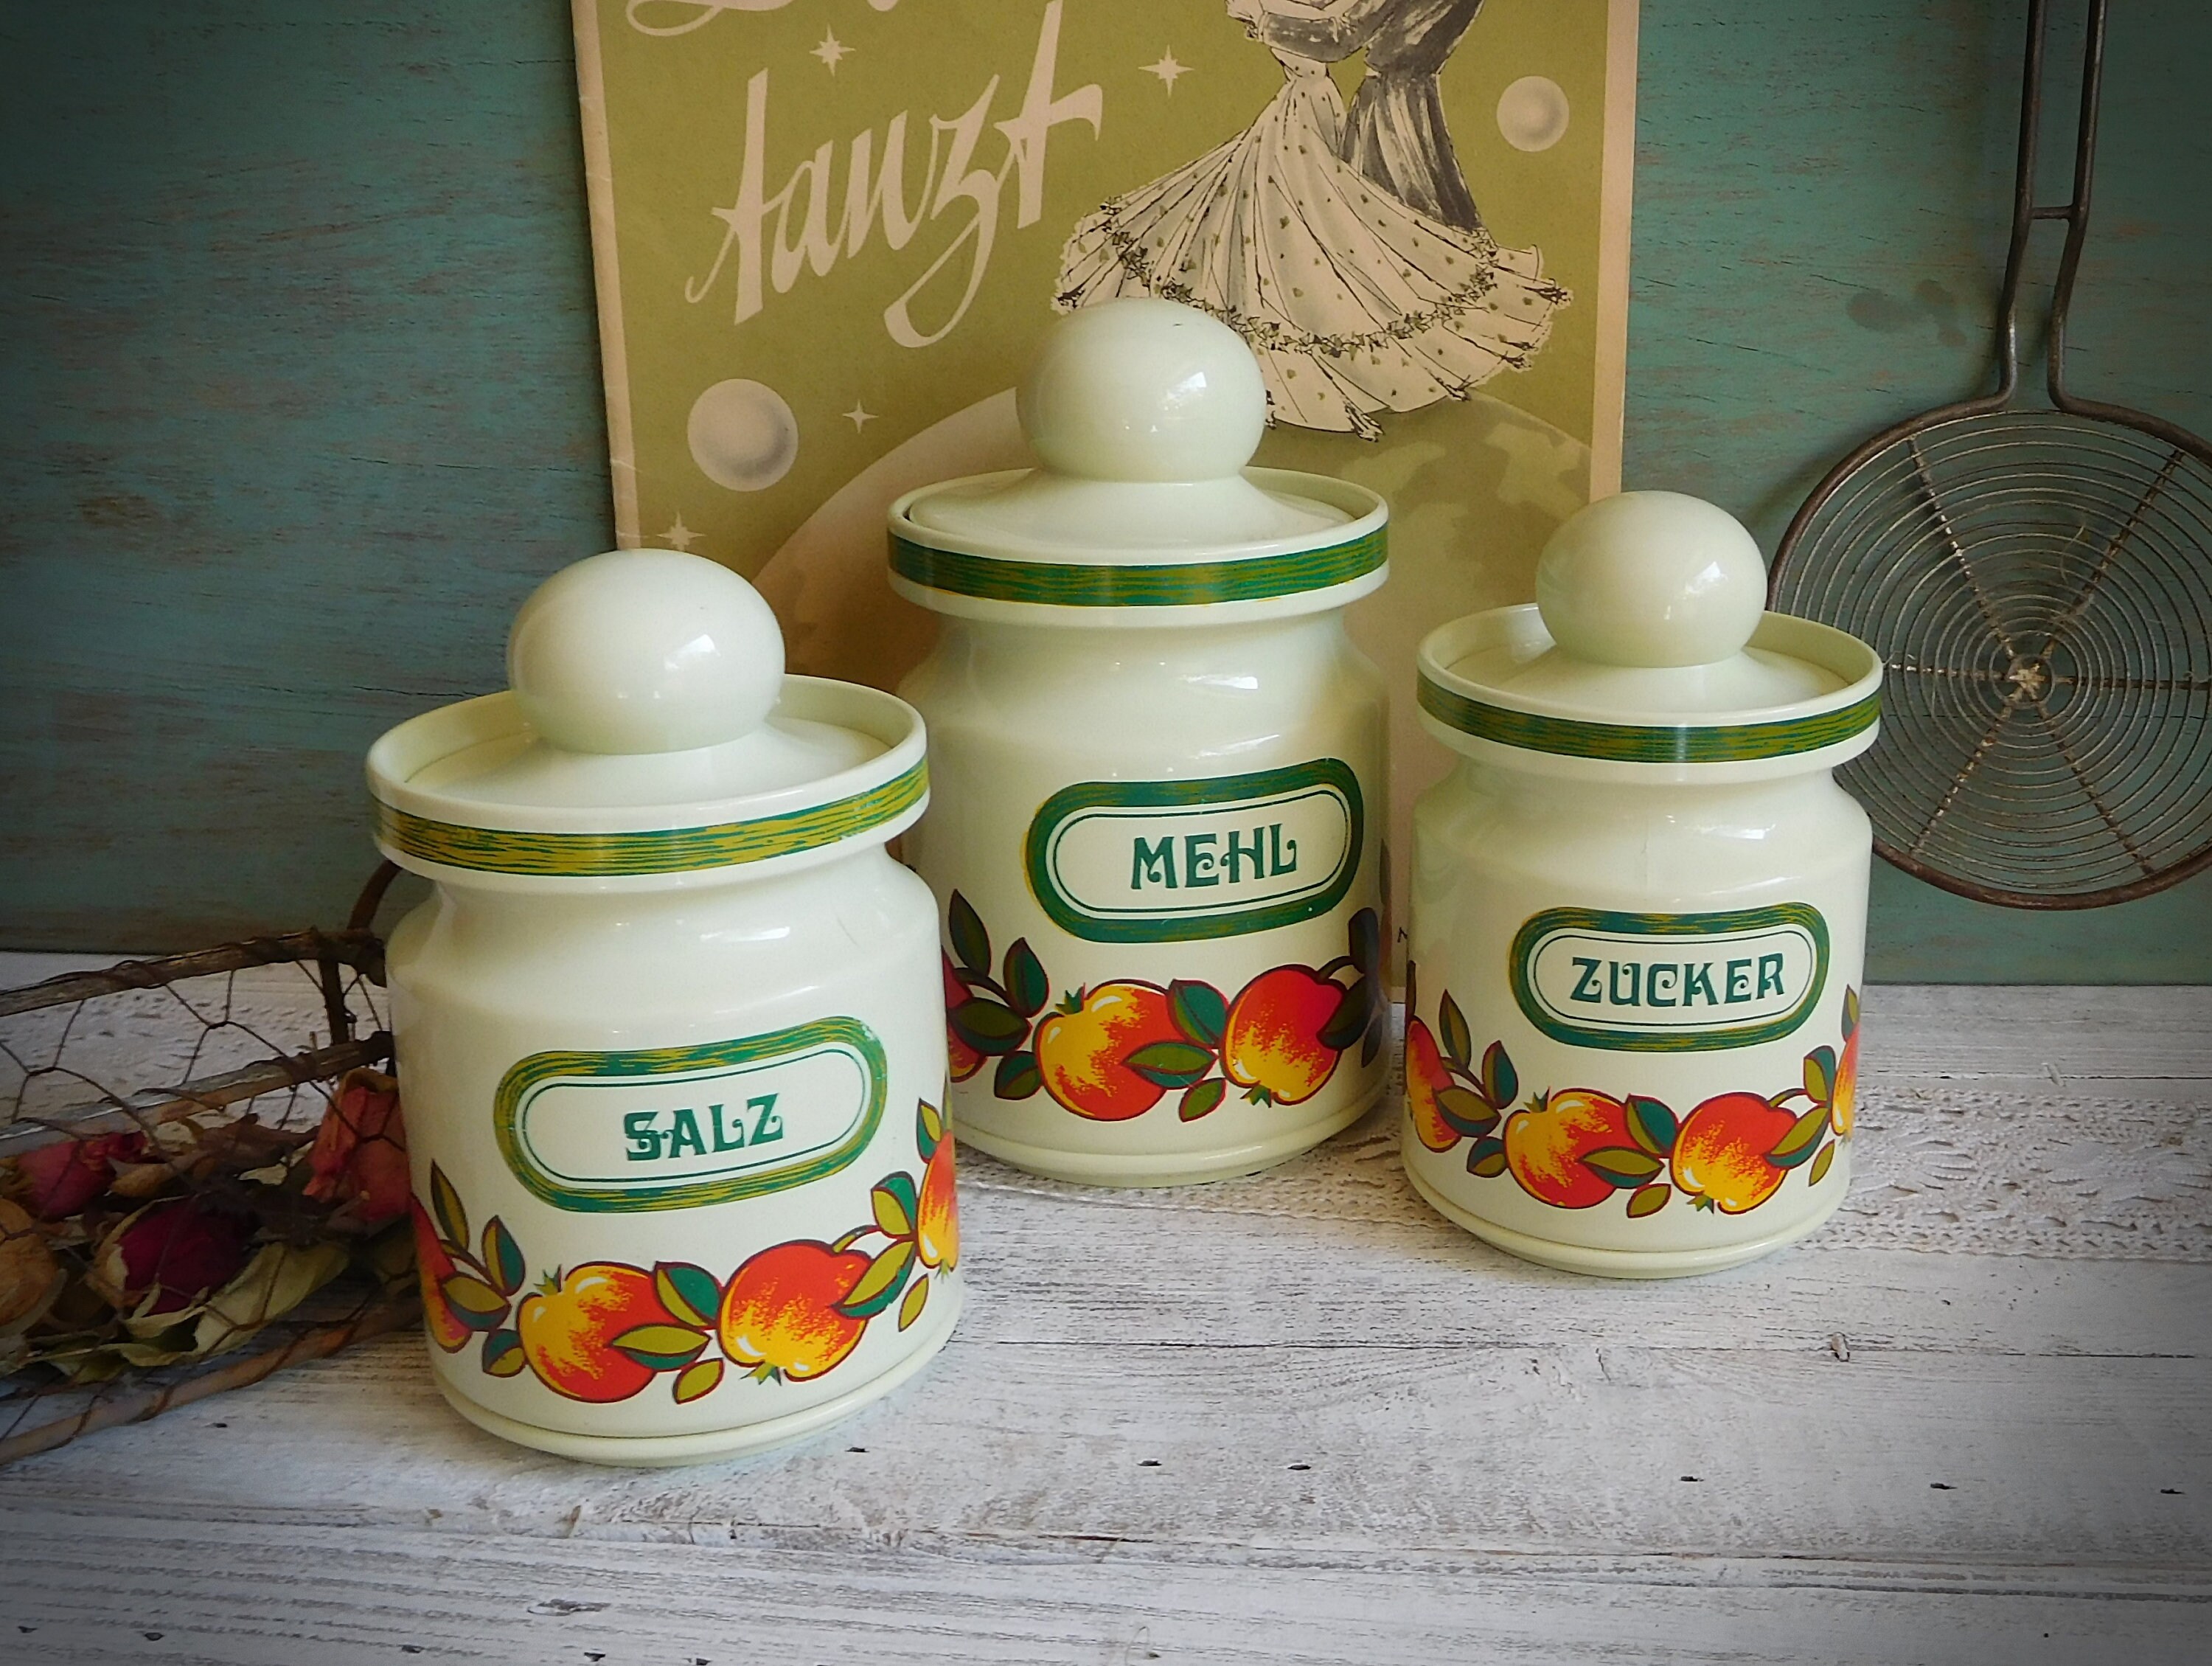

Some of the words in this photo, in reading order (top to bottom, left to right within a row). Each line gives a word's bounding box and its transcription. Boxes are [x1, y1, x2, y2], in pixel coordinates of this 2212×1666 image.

[685, 0, 1103, 348] tanzt
[1130, 823, 1297, 889] MEHL
[1570, 952, 1785, 1007] ZUCKER
[623, 1092, 784, 1162] SALZ
